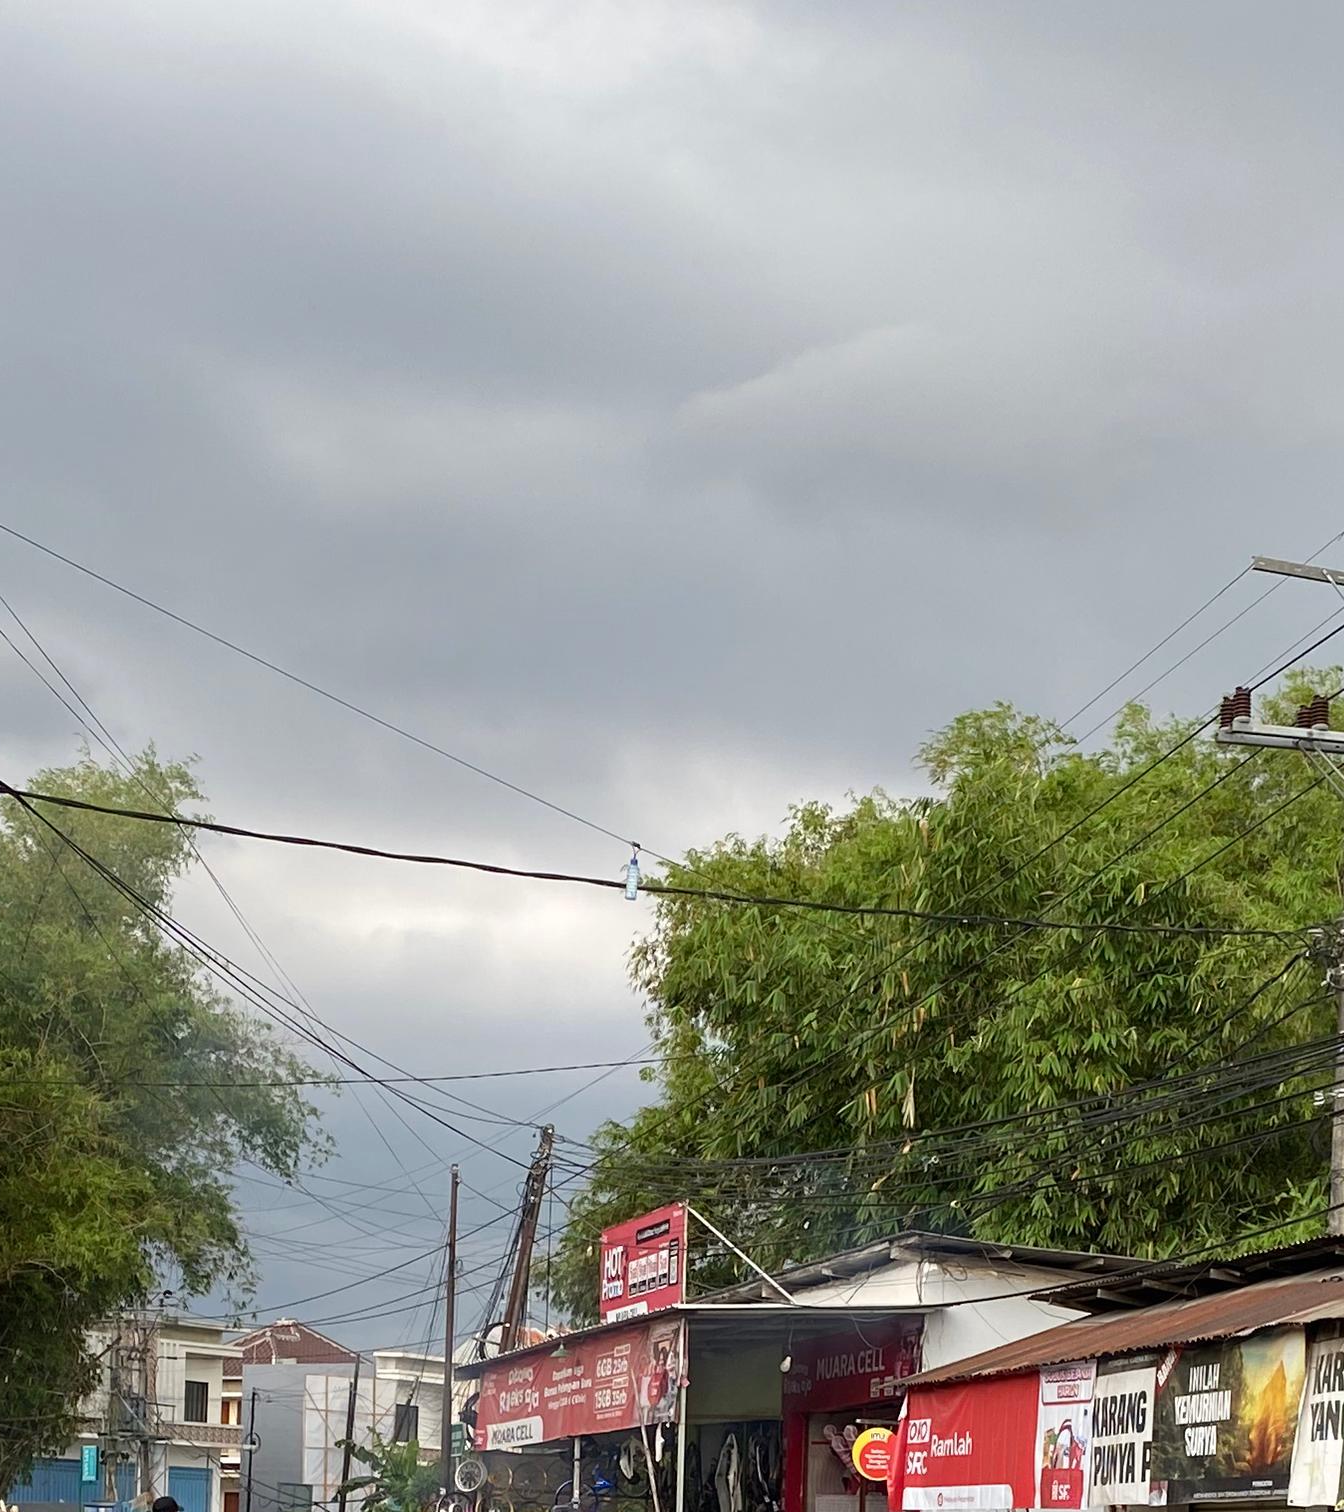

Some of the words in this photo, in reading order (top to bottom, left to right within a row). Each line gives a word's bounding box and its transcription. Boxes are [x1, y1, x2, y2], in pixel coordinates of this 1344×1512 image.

[605, 1245, 624, 1281] HOT
[816, 1354, 856, 1381] MUARA
[857, 1346, 886, 1374] CELL
[1188, 1363, 1221, 1392] INILAH
[1092, 1391, 1147, 1438] KARANG
[516, 1423, 533, 1440] CELL
[930, 1432, 973, 1457] Ramlah
[1185, 1425, 1218, 1457] SURYA
[1093, 1442, 1136, 1487] PUNYA
